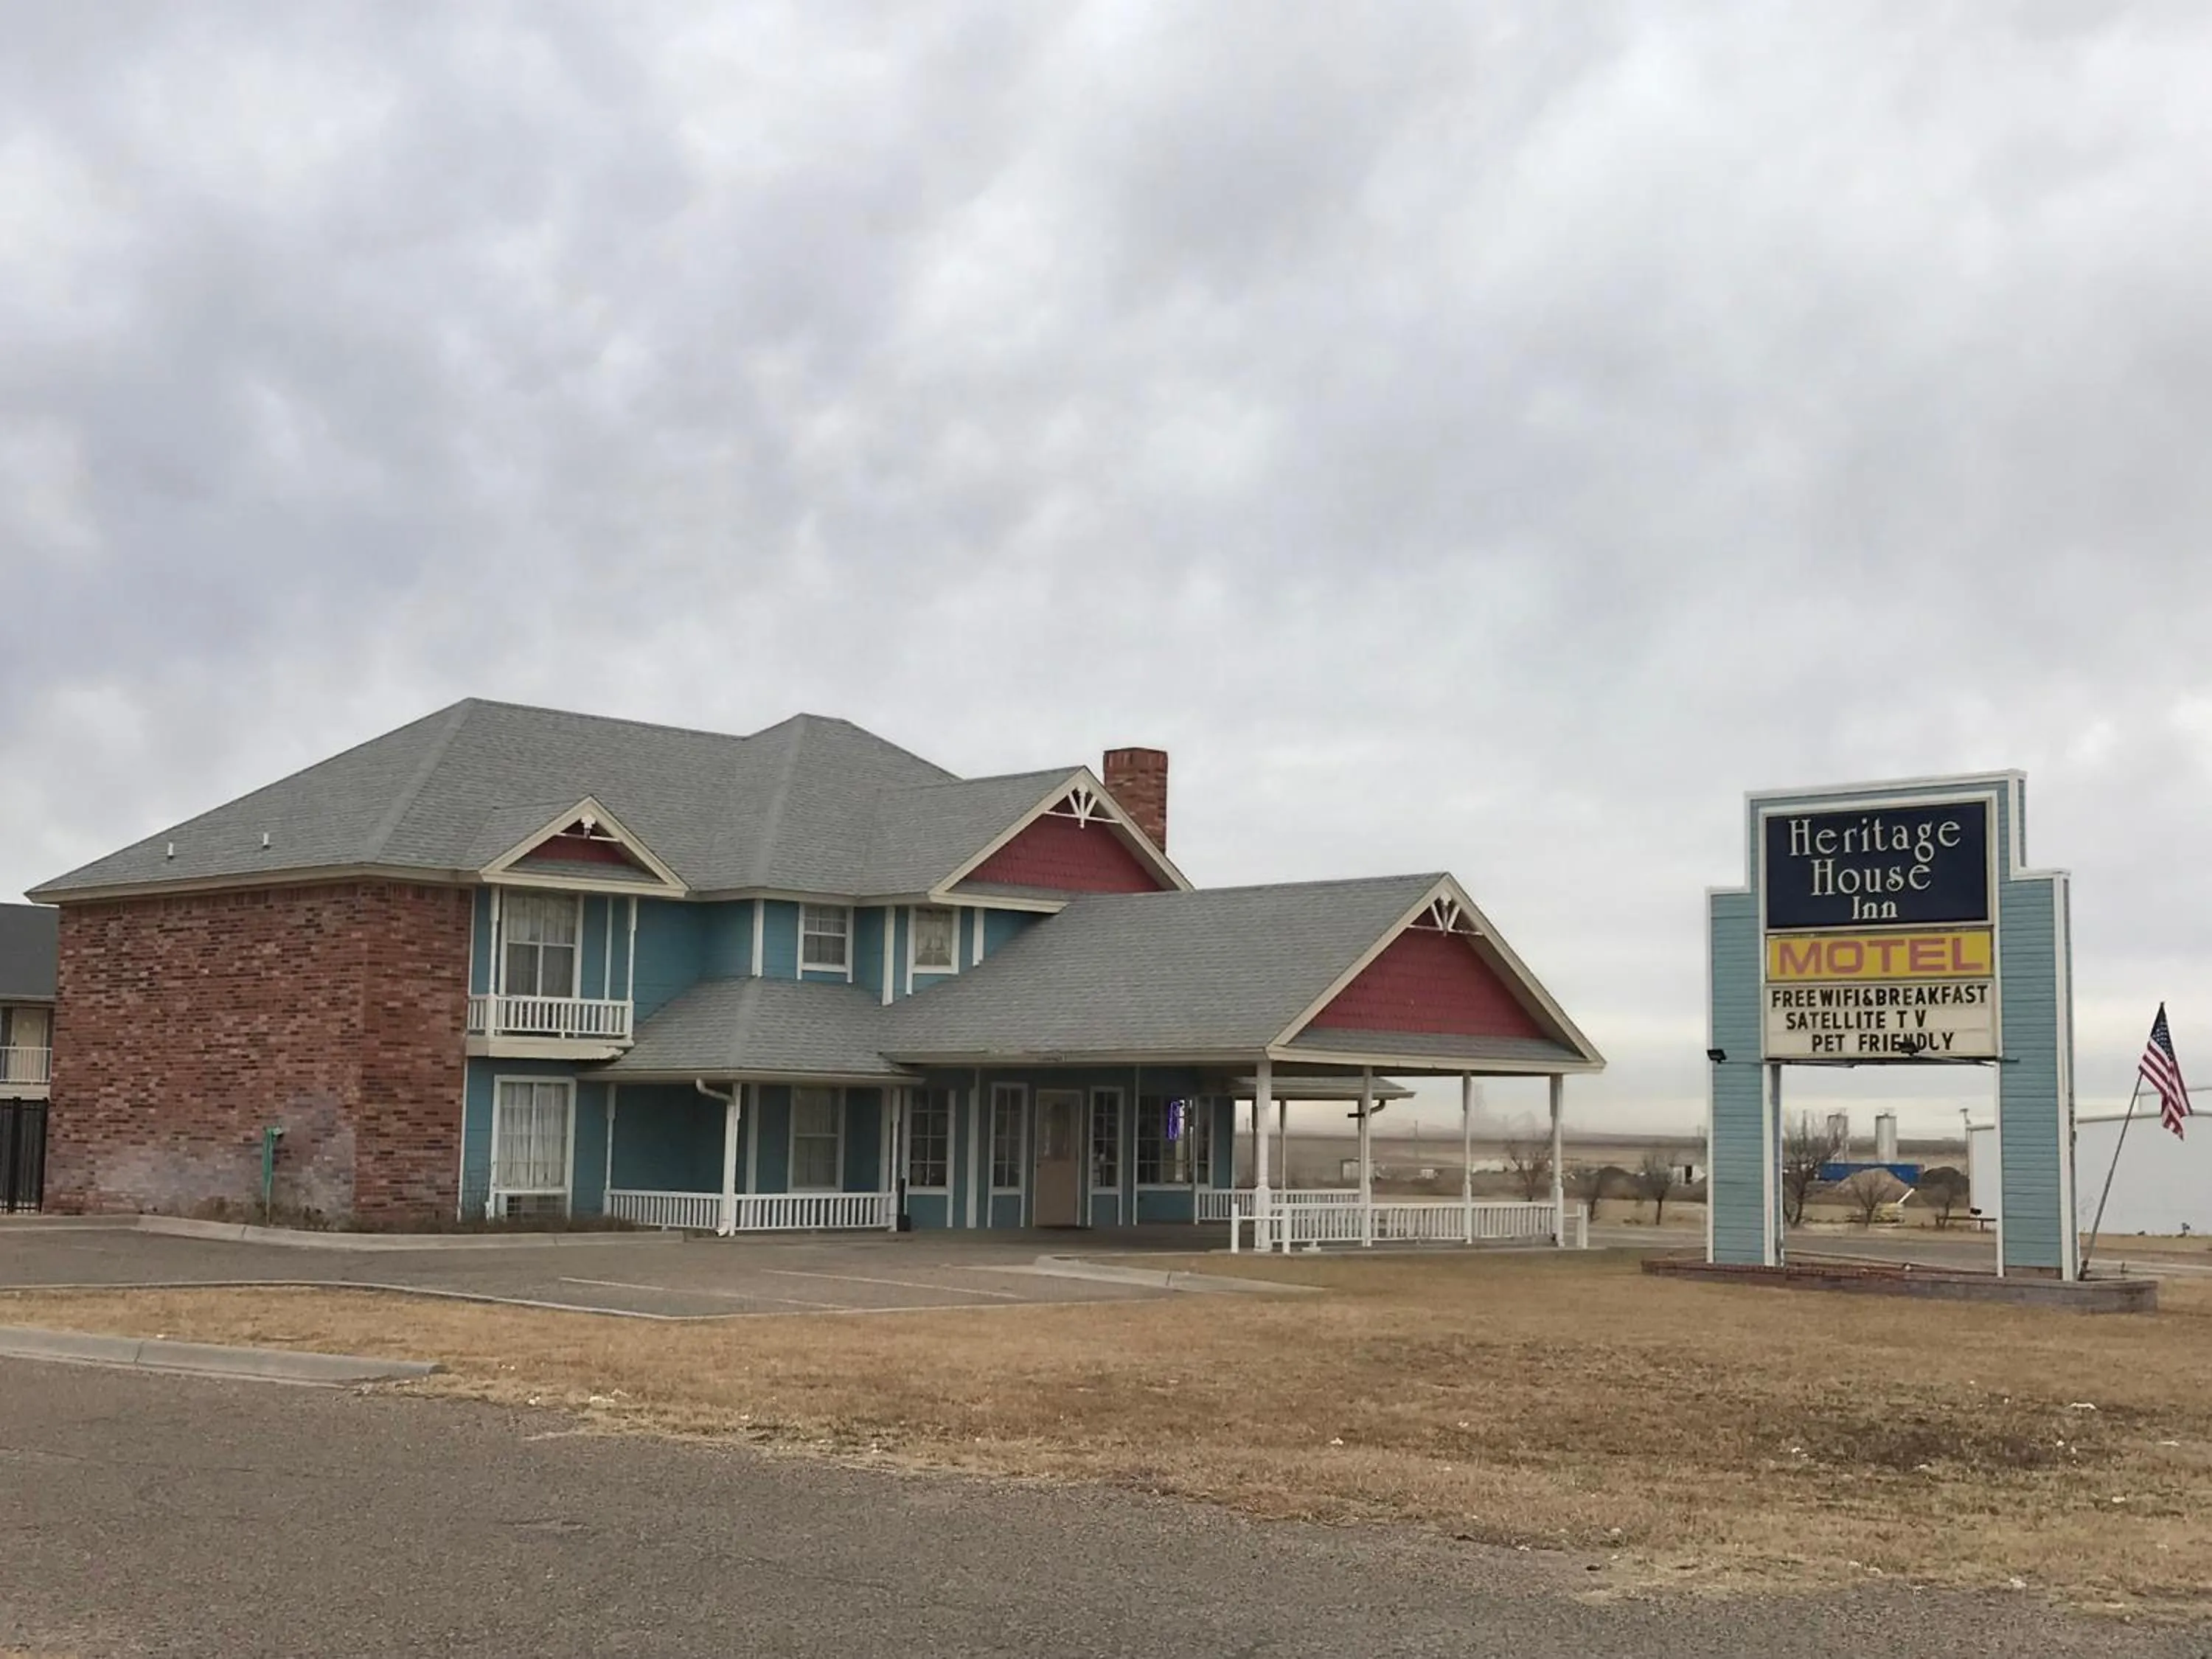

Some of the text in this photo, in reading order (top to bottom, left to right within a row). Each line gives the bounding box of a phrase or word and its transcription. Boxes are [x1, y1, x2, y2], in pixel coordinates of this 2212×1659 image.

[1788, 818, 1961, 863] Heritage
[1811, 858, 1932, 896] House
[1852, 896, 1898, 919] Inn
[1778, 938, 1983, 975] MOTEL
[1786, 1011, 1886, 1030] SATELLITE
[1812, 1034, 1845, 1052] PET
